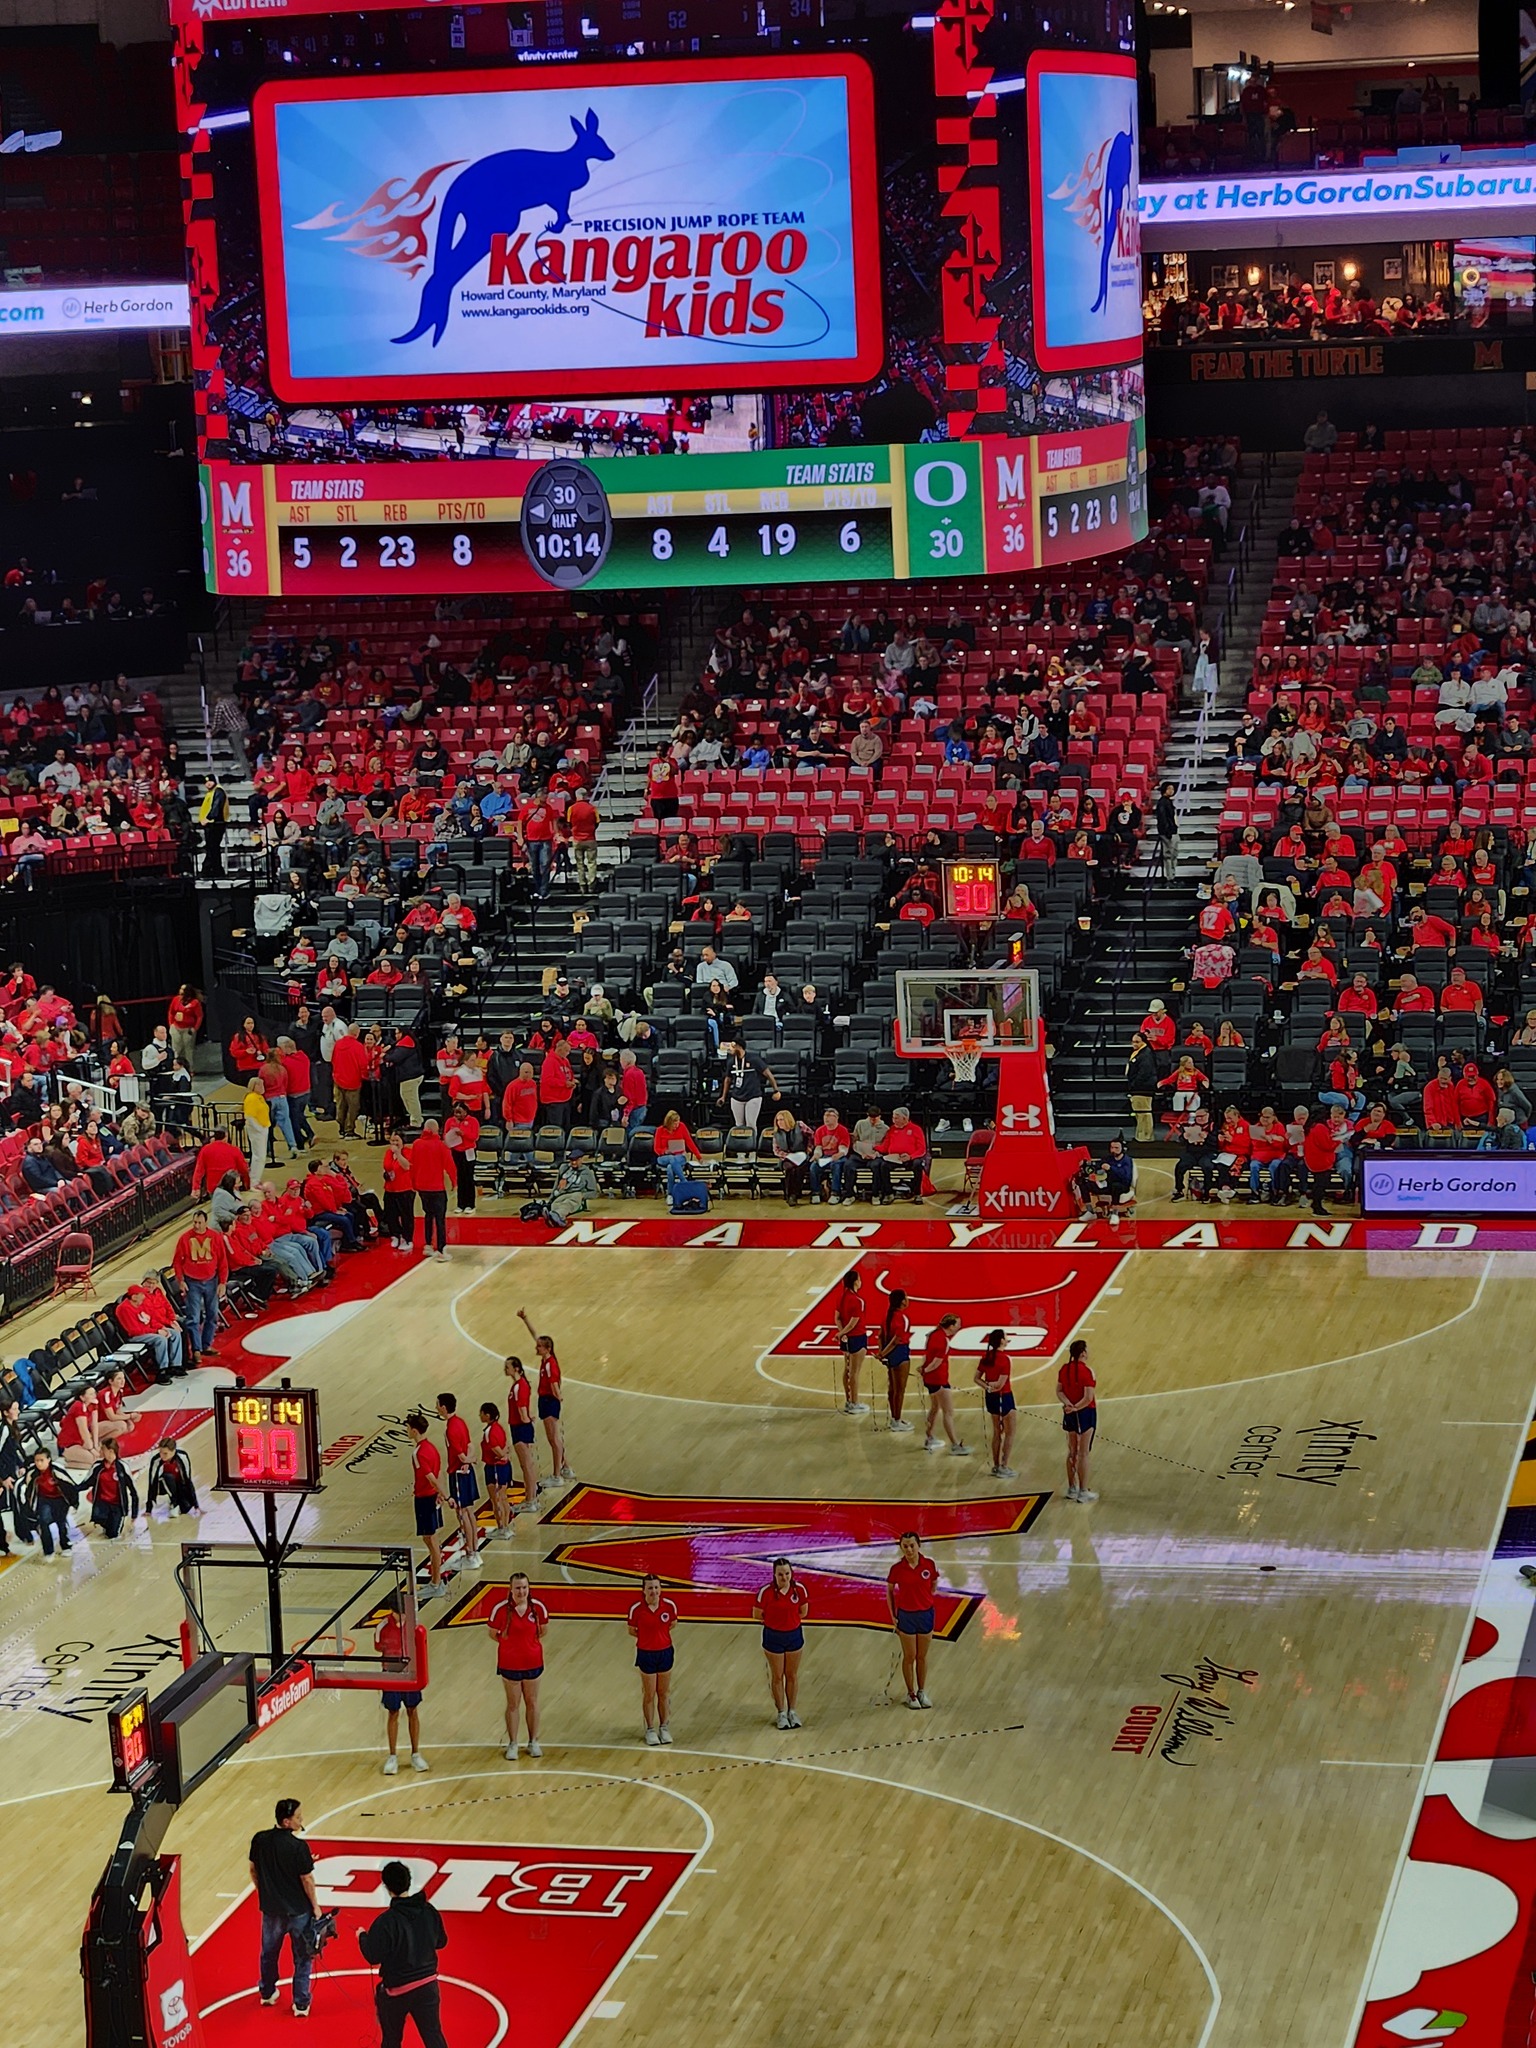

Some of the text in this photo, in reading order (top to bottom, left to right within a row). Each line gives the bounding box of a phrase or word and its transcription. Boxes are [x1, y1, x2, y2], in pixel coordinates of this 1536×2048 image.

[1174, 187, 1207, 210] at
[584, 211, 805, 234] PRECISION JUMP ROPE TEAM
[487, 229, 808, 293] Kangaroo
[84, 298, 173, 314] Herb Gordon
[461, 285, 606, 302] Howard County, Maryland
[461, 302, 590, 318] www.kangarookids.org
[644, 278, 786, 338] kids
[1191, 345, 1384, 381] FEAR THE TURTLE
[786, 462, 875, 486] TEAM STATS
[913, 461, 968, 507] O
[995, 454, 1026, 502] M
[291, 478, 364, 500] TEAM STATS
[553, 486, 576, 505] 30
[219, 482, 254, 527] M
[289, 502, 486, 524] AST STL REB PTS/TO
[647, 495, 674, 515] AST
[704, 493, 731, 514] STL
[1047, 506, 1058, 538] 5
[1070, 502, 1080, 534] 2
[1086, 498, 1101, 531] 23
[1110, 494, 1118, 525] 8
[551, 513, 578, 530] HALF
[293, 535, 473, 569] 5 2 23 8
[535, 532, 601, 559] 10:14
[652, 521, 861, 560] 8 4 19 6
[929, 528, 964, 559] 30
[1003, 523, 1025, 554] 36
[226, 548, 253, 577] 36
[953, 866, 994, 883] 10:14
[954, 884, 989, 912] 30
[1397, 1177, 1517, 1192] Herb Gordon
[984, 1184, 1061, 1213] xfinity
[547, 1221, 1479, 1248] MARYLAND
[190, 1237, 213, 1261] M
[235, 1398, 302, 1425] 10:14
[238, 1428, 298, 1476] 30
[243, 1478, 290, 1486] DAKTRONICS
[1111, 1705, 1163, 1755] COURT
